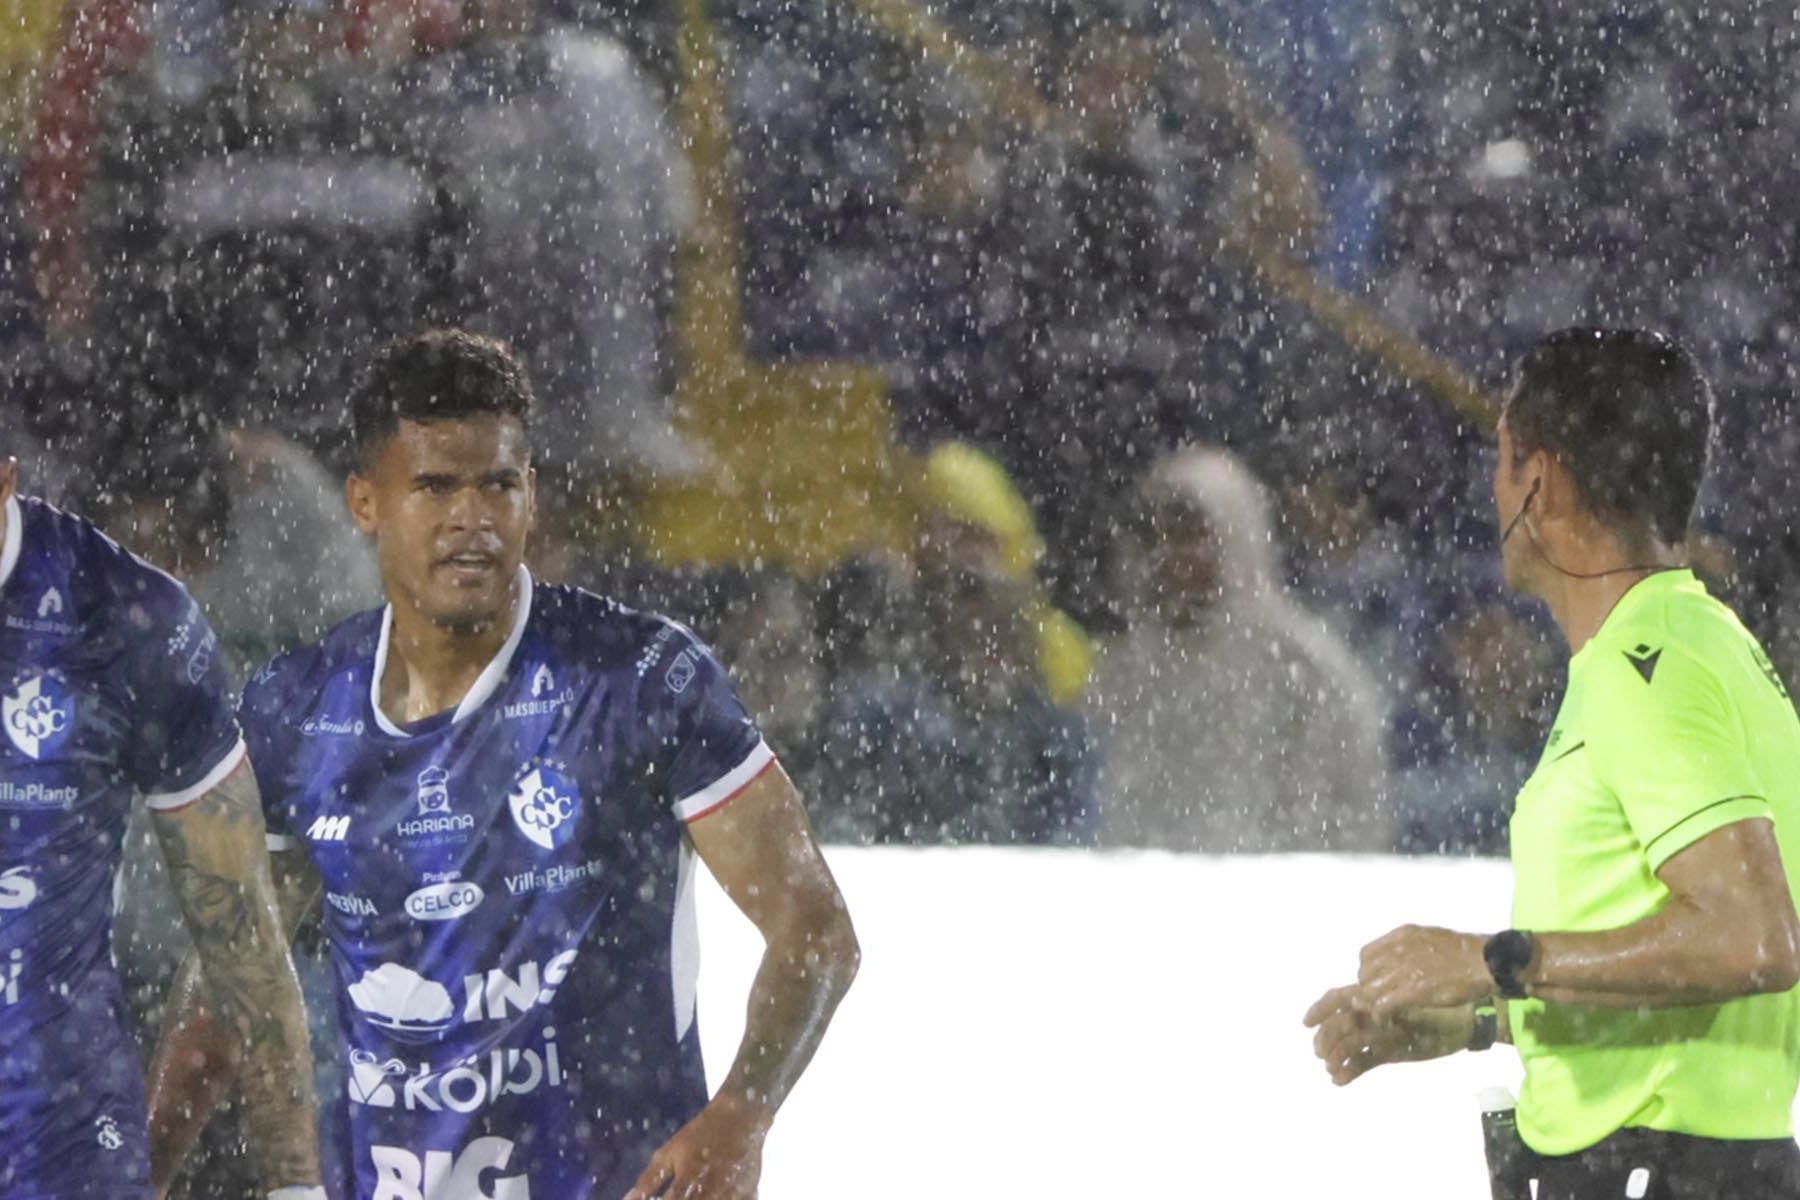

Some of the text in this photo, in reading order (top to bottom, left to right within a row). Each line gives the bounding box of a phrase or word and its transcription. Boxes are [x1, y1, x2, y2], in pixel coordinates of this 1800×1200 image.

[397, 814, 474, 837] HARIANA
[411, 889, 476, 913] CELCO
[463, 948, 579, 1022] INS
